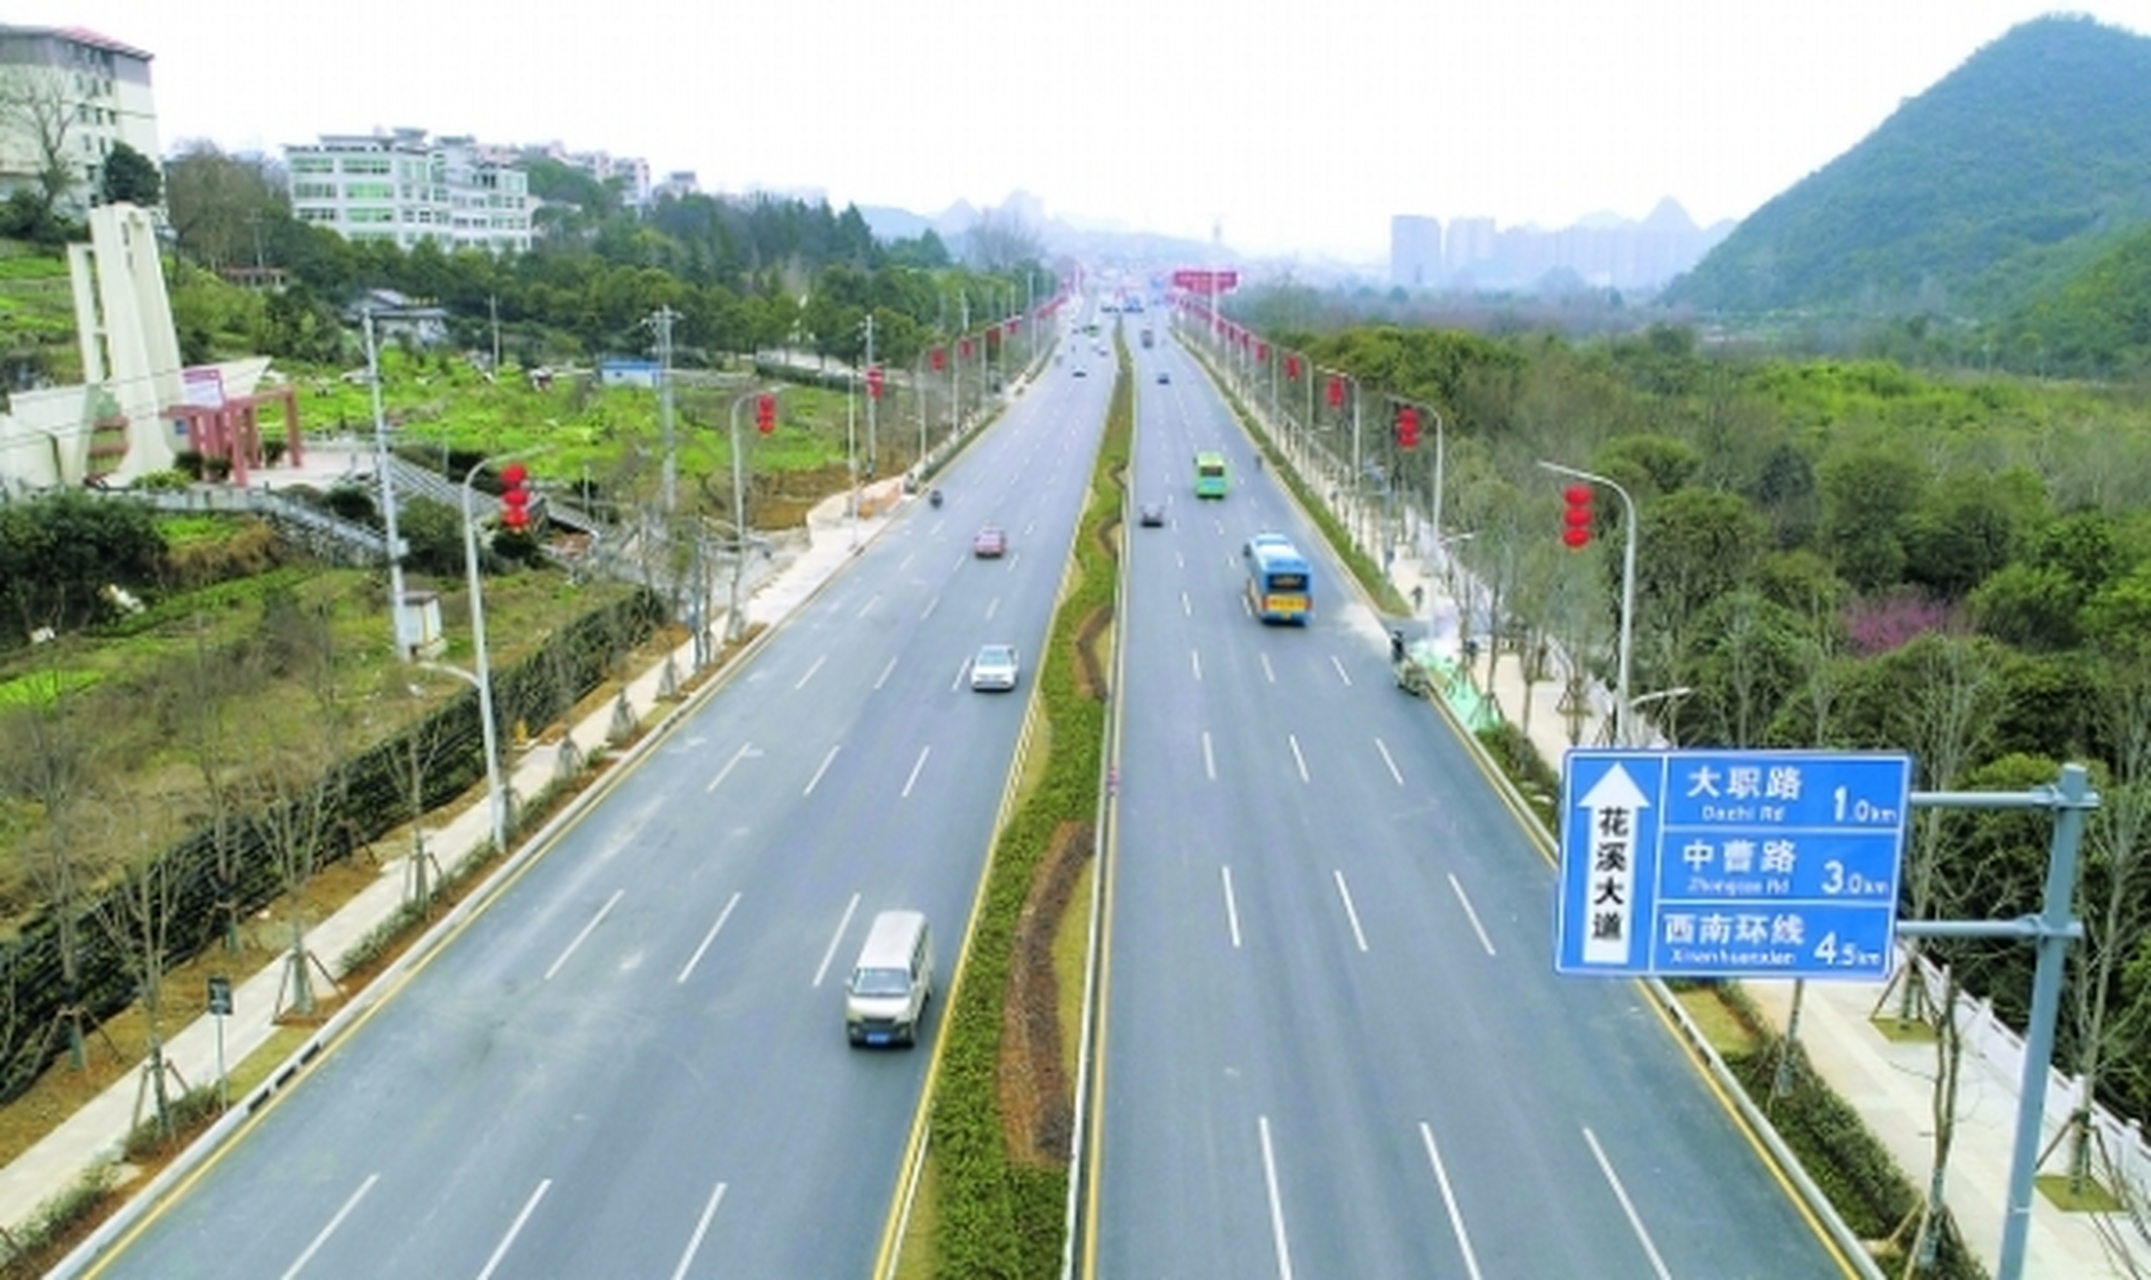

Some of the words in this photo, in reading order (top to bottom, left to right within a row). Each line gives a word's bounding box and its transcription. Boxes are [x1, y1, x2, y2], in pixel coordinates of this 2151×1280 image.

[1687, 766, 1802, 800] 大职路
[1759, 805, 1786, 822] Rd
[1834, 785, 1897, 823] 1.0km
[1683, 838, 1797, 873] 中曹路
[1592, 806, 1630, 941] 花溪大道
[1821, 860, 1889, 895] 3.0km
[1663, 912, 1805, 946] 西南环线
[1813, 931, 1881, 966] 4.5km
